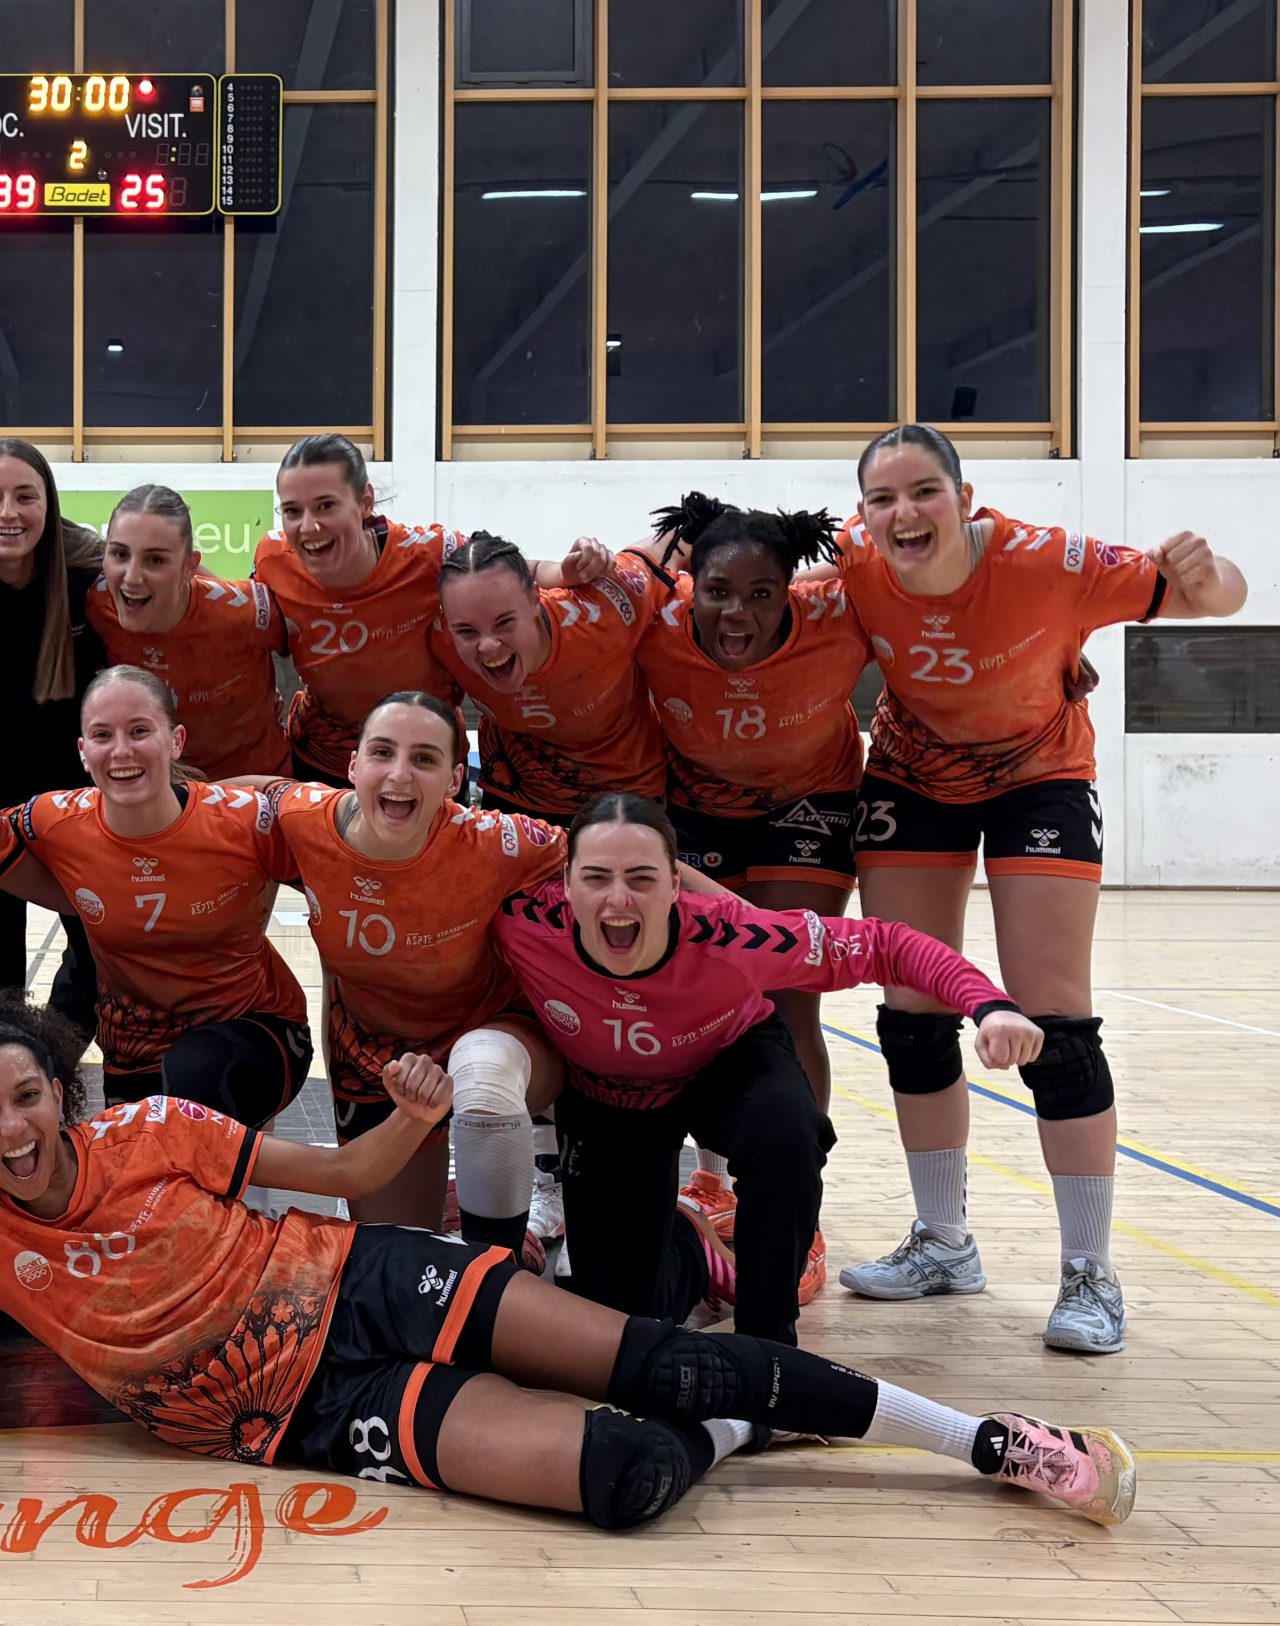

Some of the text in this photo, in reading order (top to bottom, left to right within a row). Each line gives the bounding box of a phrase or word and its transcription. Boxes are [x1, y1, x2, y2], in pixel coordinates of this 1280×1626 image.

[30, 76, 130, 112] 30:00
[226, 83, 234, 91] 4
[226, 93, 234, 102] 5
[226, 103, 234, 112] 6
[125, 113, 187, 138] VISIT.
[226, 114, 234, 122] 7
[226, 124, 234, 133] 8
[226, 134, 234, 143] 9
[69, 140, 88, 169] 2
[222, 145, 234, 154] 10
[222, 155, 234, 164] 11
[222, 166, 234, 174] 12
[222, 176, 234, 185] 13
[48, 187, 107, 203] Bodet
[121, 174, 166, 208] 25
[222, 186, 234, 195] 14
[222, 196, 234, 205] 15
[310, 619, 369, 654] 20
[908, 644, 973, 685] 23
[521, 704, 557, 729] 5
[715, 705, 767, 740] 18
[855, 800, 897, 842] 23
[1025, 845, 1061, 855] hummel
[134, 892, 167, 933] 7
[338, 909, 396, 956] 10
[612, 1000, 647, 1013] hummel
[602, 1018, 662, 1056] 16
[17, 1257, 43, 1274] SPORT
[25, 1267, 47, 1283] 2000
[435, 1269, 458, 1307] hummel
